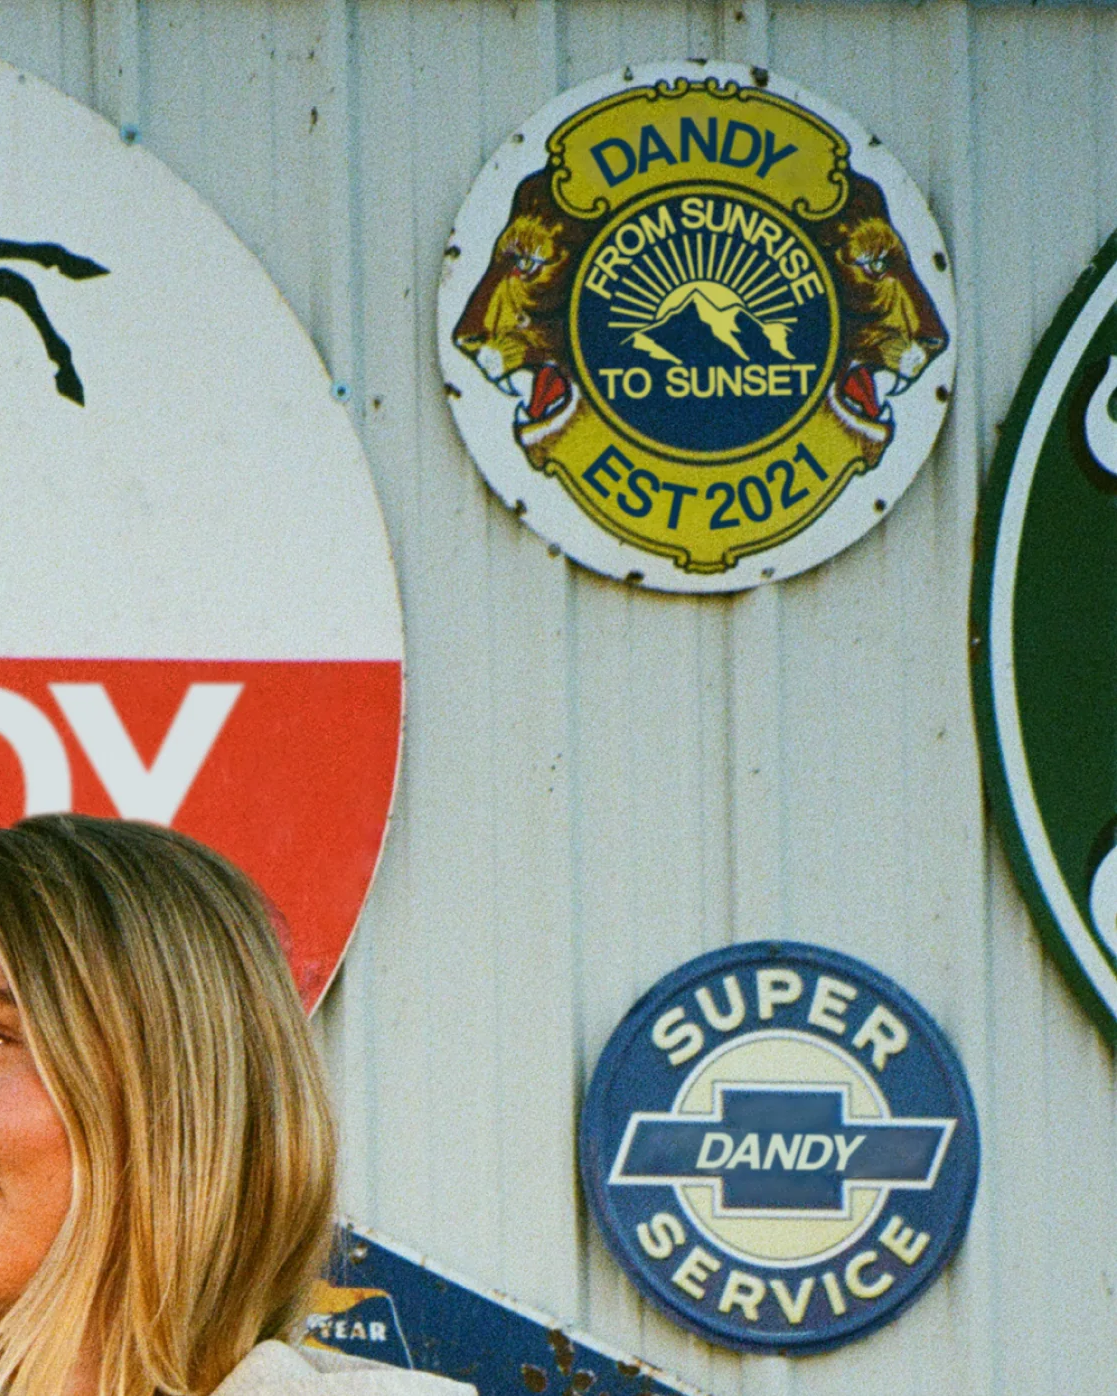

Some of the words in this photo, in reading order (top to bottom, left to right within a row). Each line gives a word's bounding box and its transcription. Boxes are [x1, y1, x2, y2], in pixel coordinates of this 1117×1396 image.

[589, 116, 800, 188] DANDY
[585, 204, 677, 301] FROM
[680, 197, 826, 307] SUNRISE
[599, 366, 652, 400] TO
[665, 362, 817, 399] SUNSET
[581, 443, 698, 531] EST
[704, 442, 830, 531] 2021
[651, 967, 910, 1072] SUPER
[694, 1131, 867, 1172] DANDY
[635, 1211, 931, 1325] SERVICE
